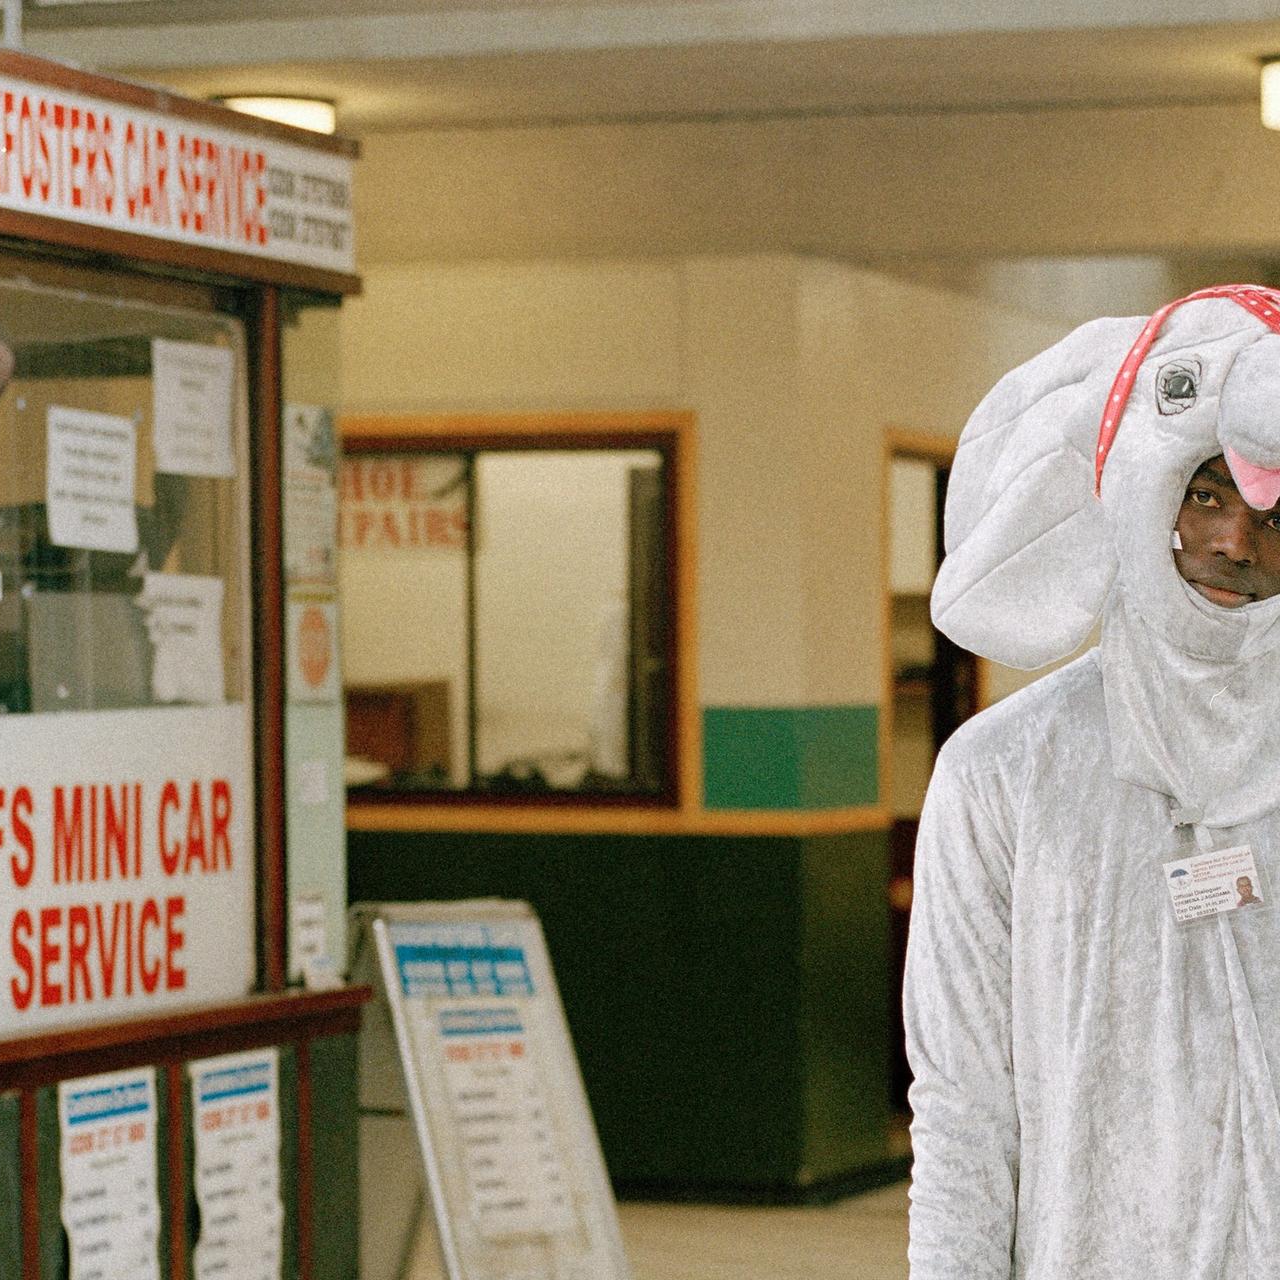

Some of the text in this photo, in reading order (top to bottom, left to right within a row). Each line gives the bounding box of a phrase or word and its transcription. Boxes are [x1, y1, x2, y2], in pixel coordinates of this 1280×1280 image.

[124, 120, 170, 226] CAR
[178, 134, 268, 247] SERVICE
[53, 783, 142, 884] MINI
[158, 779, 233, 876] CAR
[9, 896, 187, 1012] SERVICE
